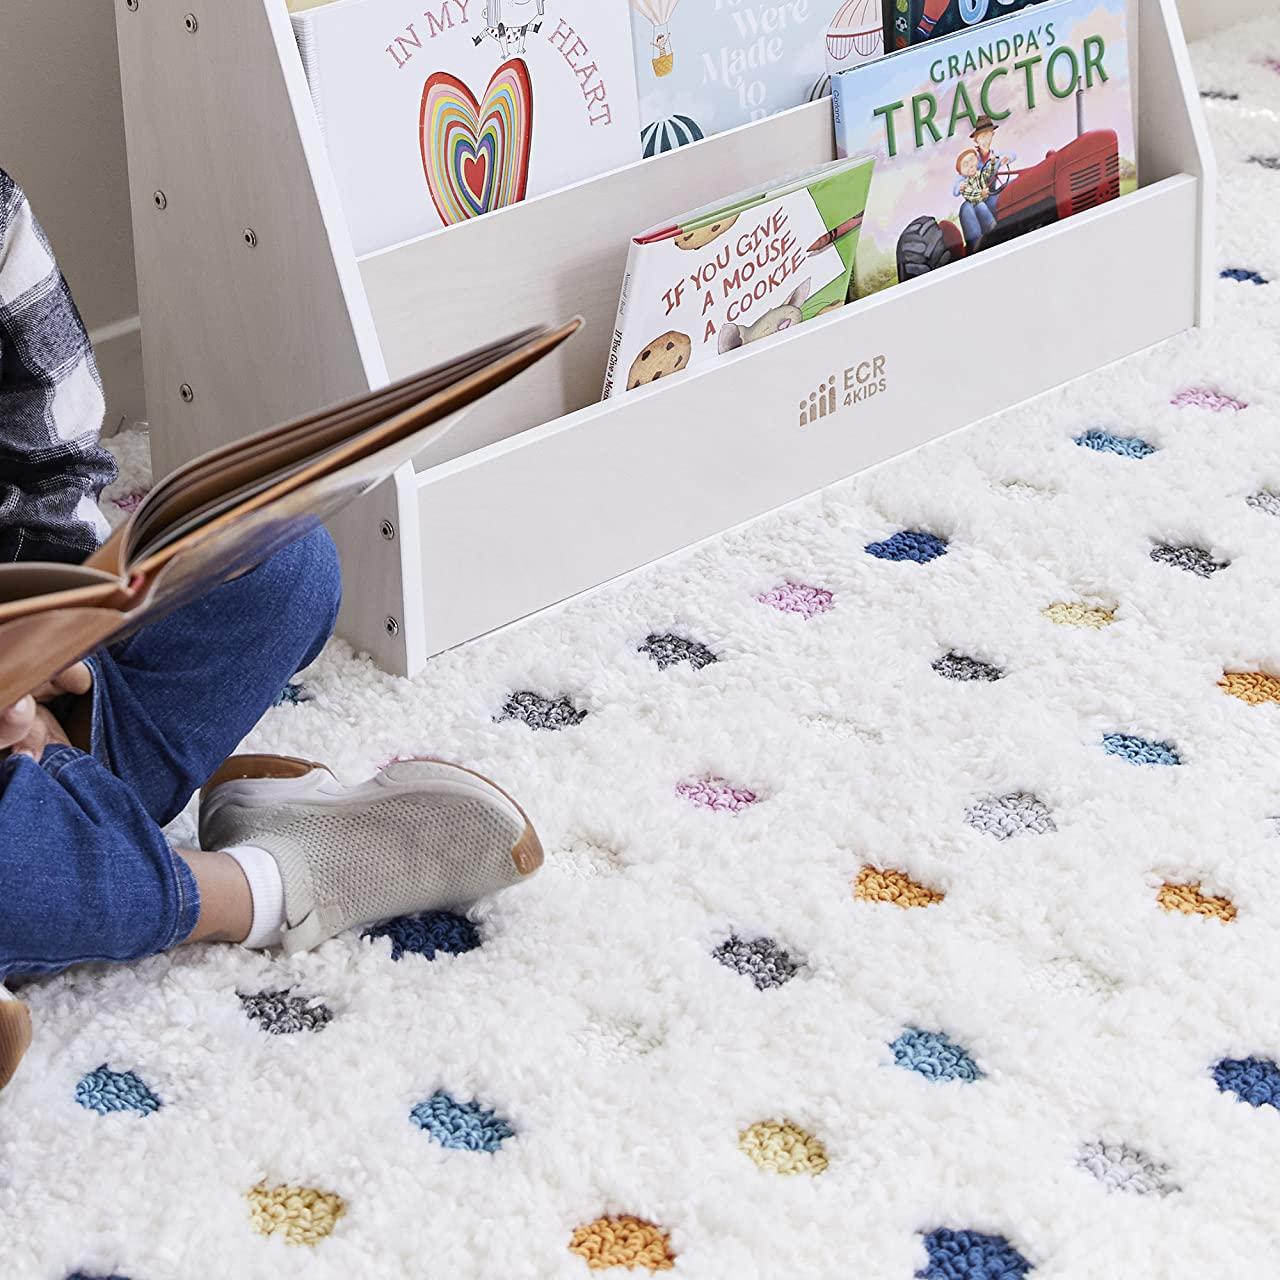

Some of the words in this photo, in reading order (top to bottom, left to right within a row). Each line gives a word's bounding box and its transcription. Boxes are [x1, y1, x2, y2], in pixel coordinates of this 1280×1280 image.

[384, 23, 423, 69] IN
[547, 18, 612, 128] HEART
[701, 36, 784, 89] Made
[874, 34, 1109, 157] TRACTOR
[929, 22, 1056, 84] GRANDPA'S
[661, 279, 685, 316] IF
[689, 246, 730, 291] YOU
[736, 206, 790, 257] GIVE
[701, 290, 715, 316] A
[723, 230, 797, 298] MOUSE
[703, 320, 717, 343] A
[725, 246, 807, 323] COOKIE
[843, 354, 886, 391] ECR
[843, 379, 887, 407] 4KIDS
